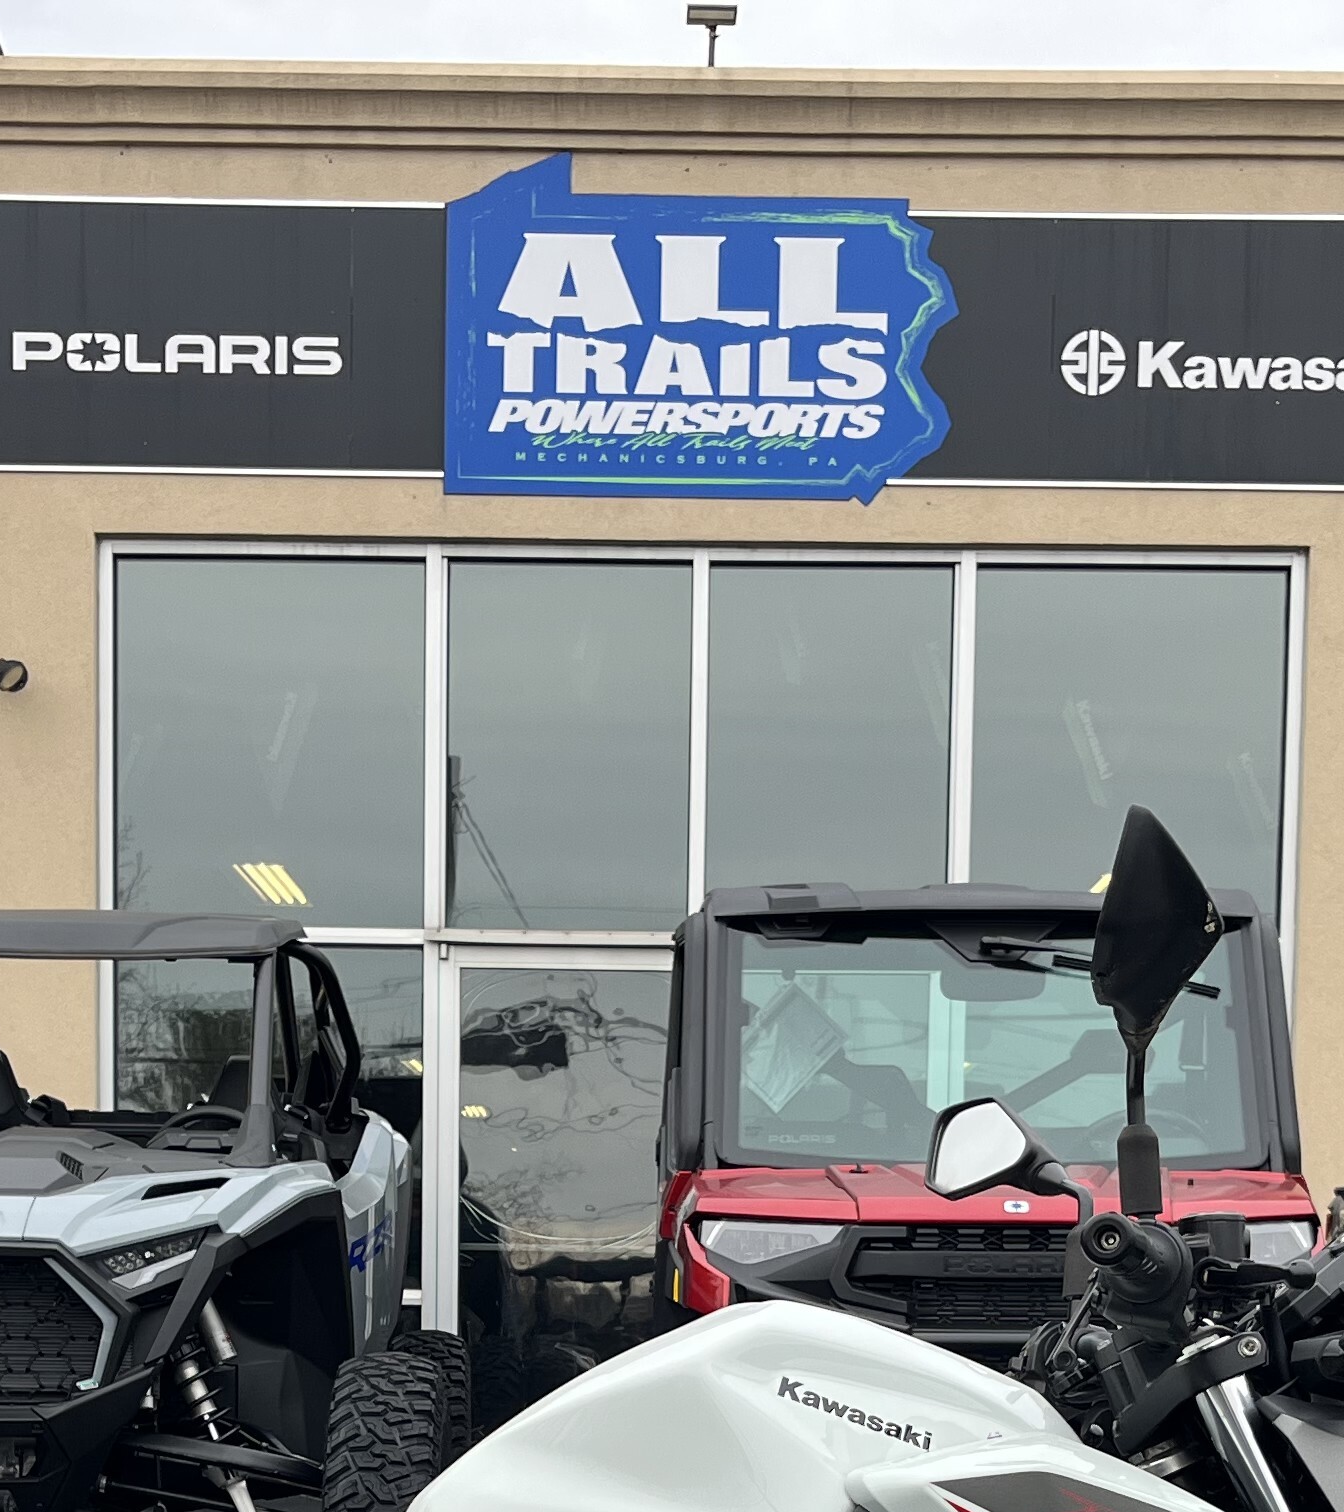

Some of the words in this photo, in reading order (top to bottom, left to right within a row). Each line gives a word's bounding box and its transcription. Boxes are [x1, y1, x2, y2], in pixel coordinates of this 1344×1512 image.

[497, 232, 888, 335] ALL
[13, 331, 343, 377] POLARIS
[487, 332, 887, 400] TRAILS
[487, 399, 886, 440] POWERSPORTS
[808, 457, 838, 467] PA
[767, 1134, 837, 1144] POLARIS
[942, 1255, 1065, 1275] POLARI
[777, 1376, 933, 1452] Kawasaki
